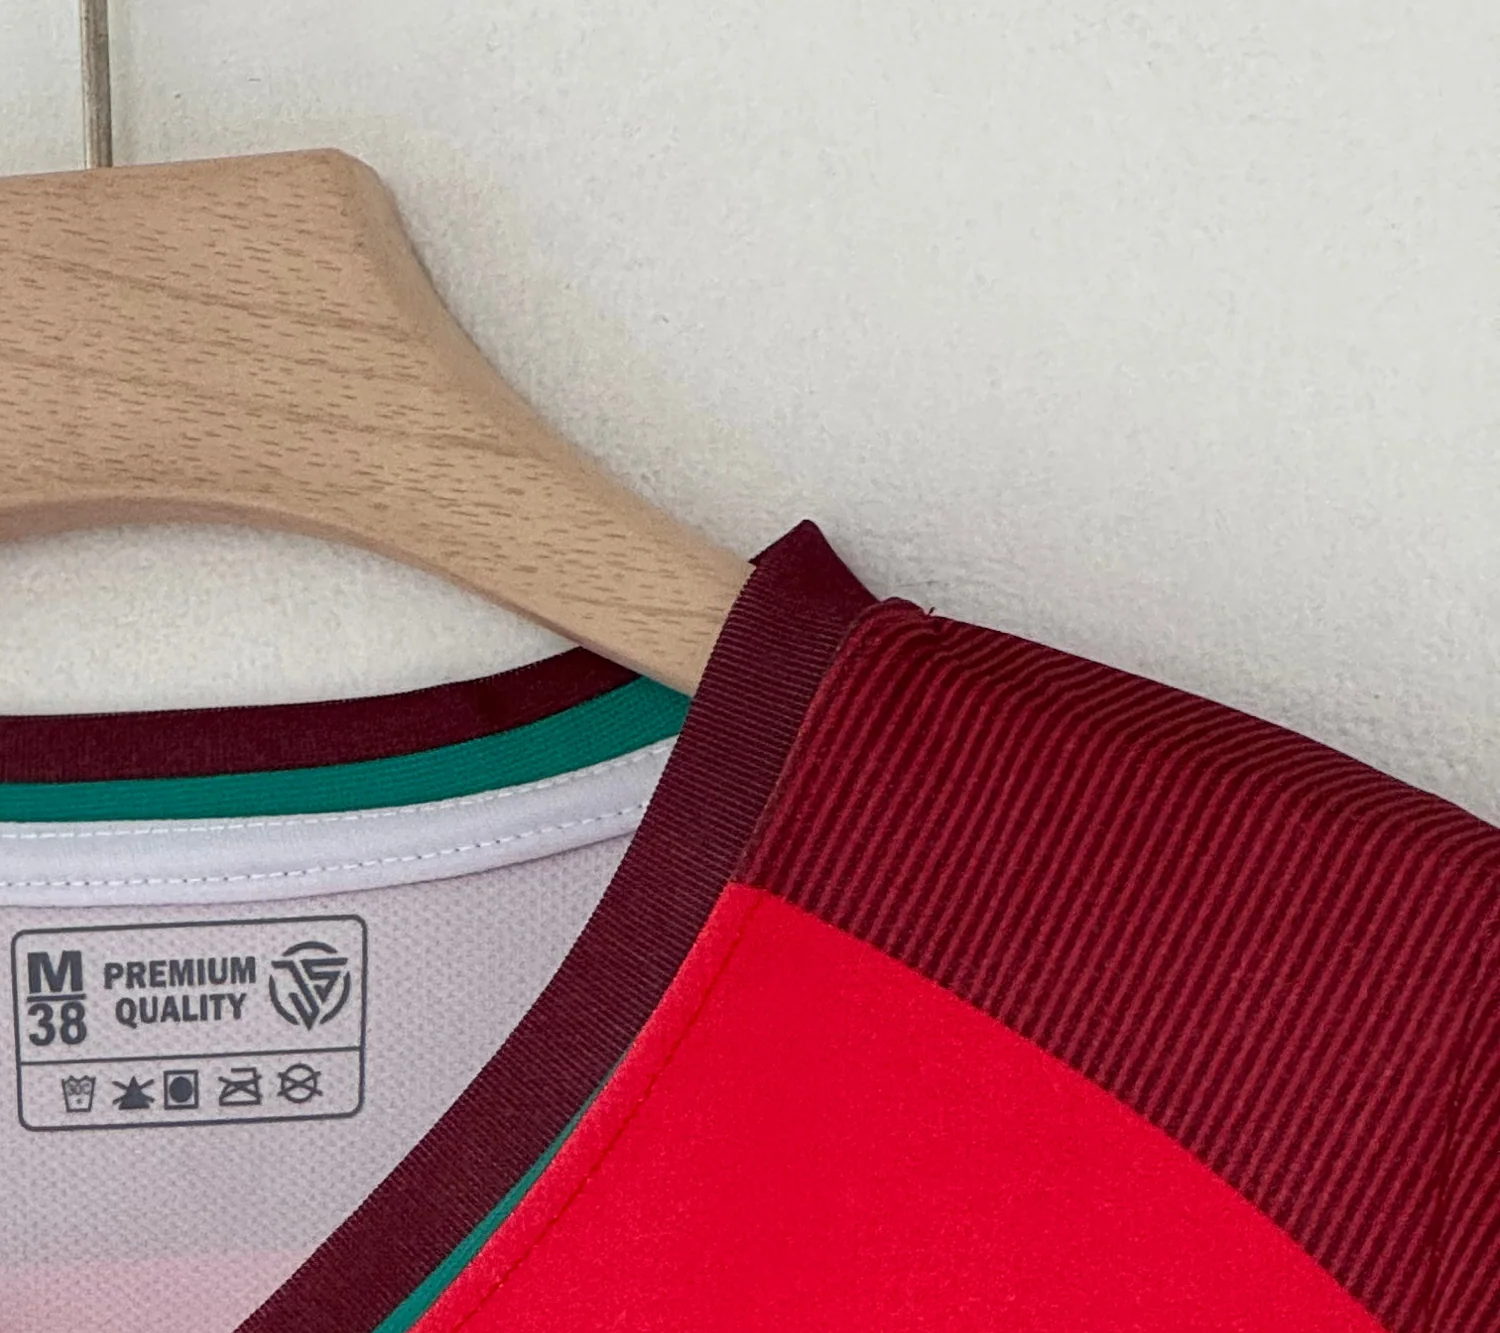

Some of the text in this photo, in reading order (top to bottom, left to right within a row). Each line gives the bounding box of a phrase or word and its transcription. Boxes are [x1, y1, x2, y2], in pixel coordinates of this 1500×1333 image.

[27, 949, 83, 994] M
[103, 956, 257, 990] PREMIUM
[27, 1001, 88, 1047] 38
[115, 993, 247, 1029] QUALITY
